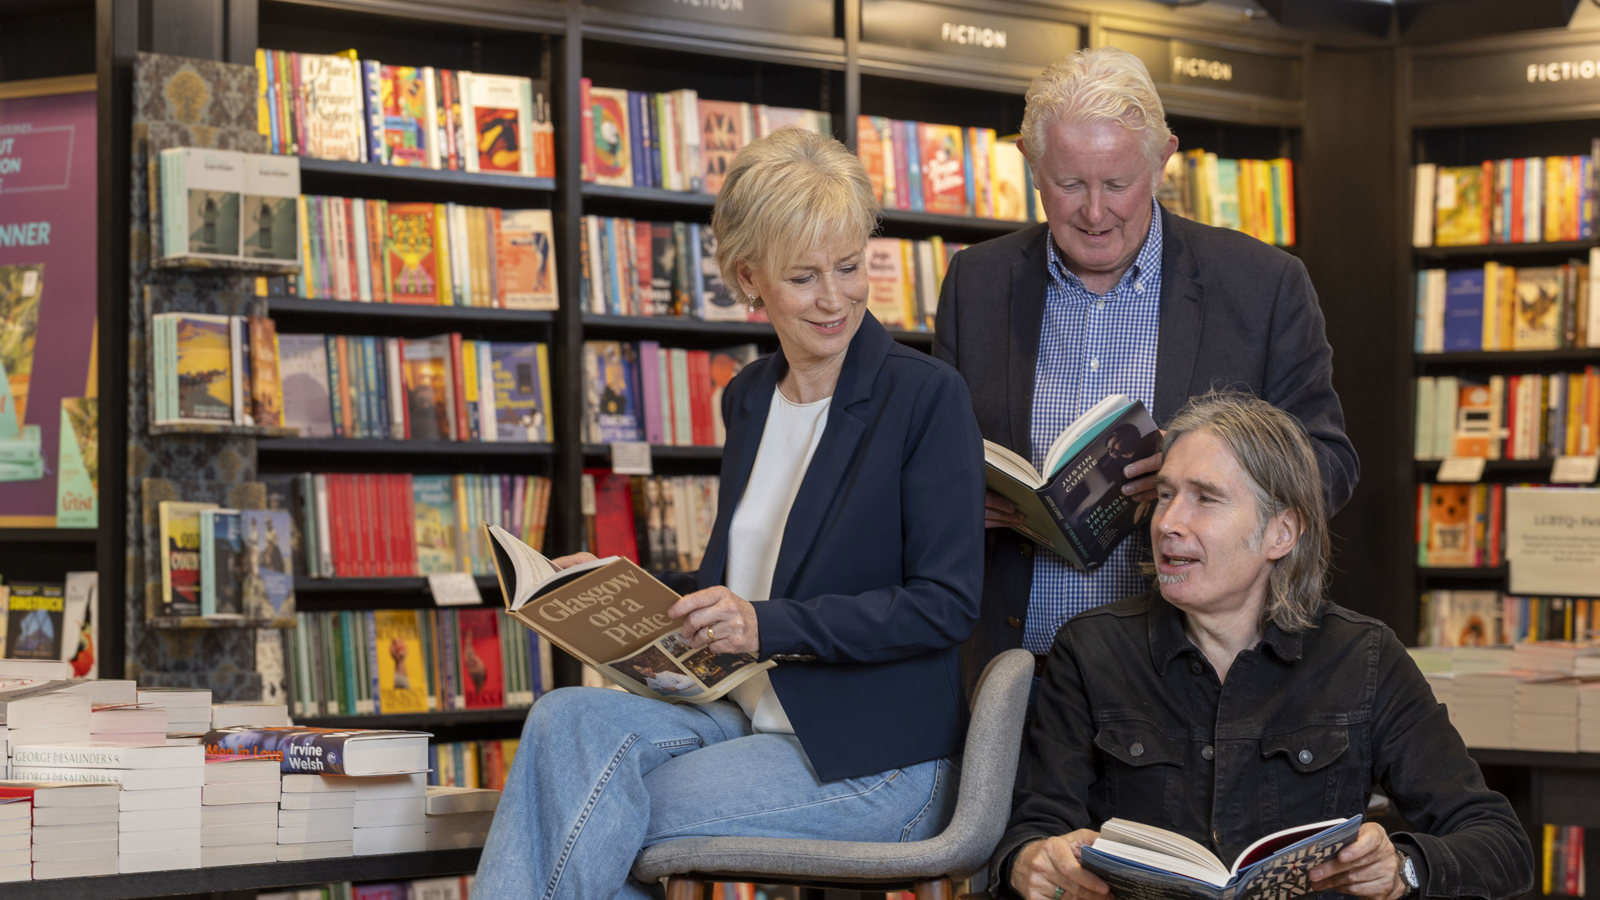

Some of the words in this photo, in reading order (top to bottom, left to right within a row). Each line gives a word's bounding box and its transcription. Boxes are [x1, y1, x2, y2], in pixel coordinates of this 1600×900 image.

[941, 22, 1007, 49] FICTION
[1174, 55, 1233, 81] FICTION
[1527, 59, 1600, 83] FICTIO
[1061, 455, 1093, 488] JUSTIN
[1065, 459, 1099, 493] CURRIE
[1085, 505, 1103, 524] THE
[1093, 500, 1128, 536] DIARIES
[538, 569, 641, 622] Glasgow
[589, 603, 626, 628] on
[621, 597, 645, 613] a
[602, 612, 674, 648] Plate
[15, 751, 51, 763] GEORGE
[63, 754, 114, 766] SAUNDERS
[288, 756, 325, 771] Welsh
[289, 742, 323, 757] Irvine
[1246, 843, 1344, 890] GOOD
